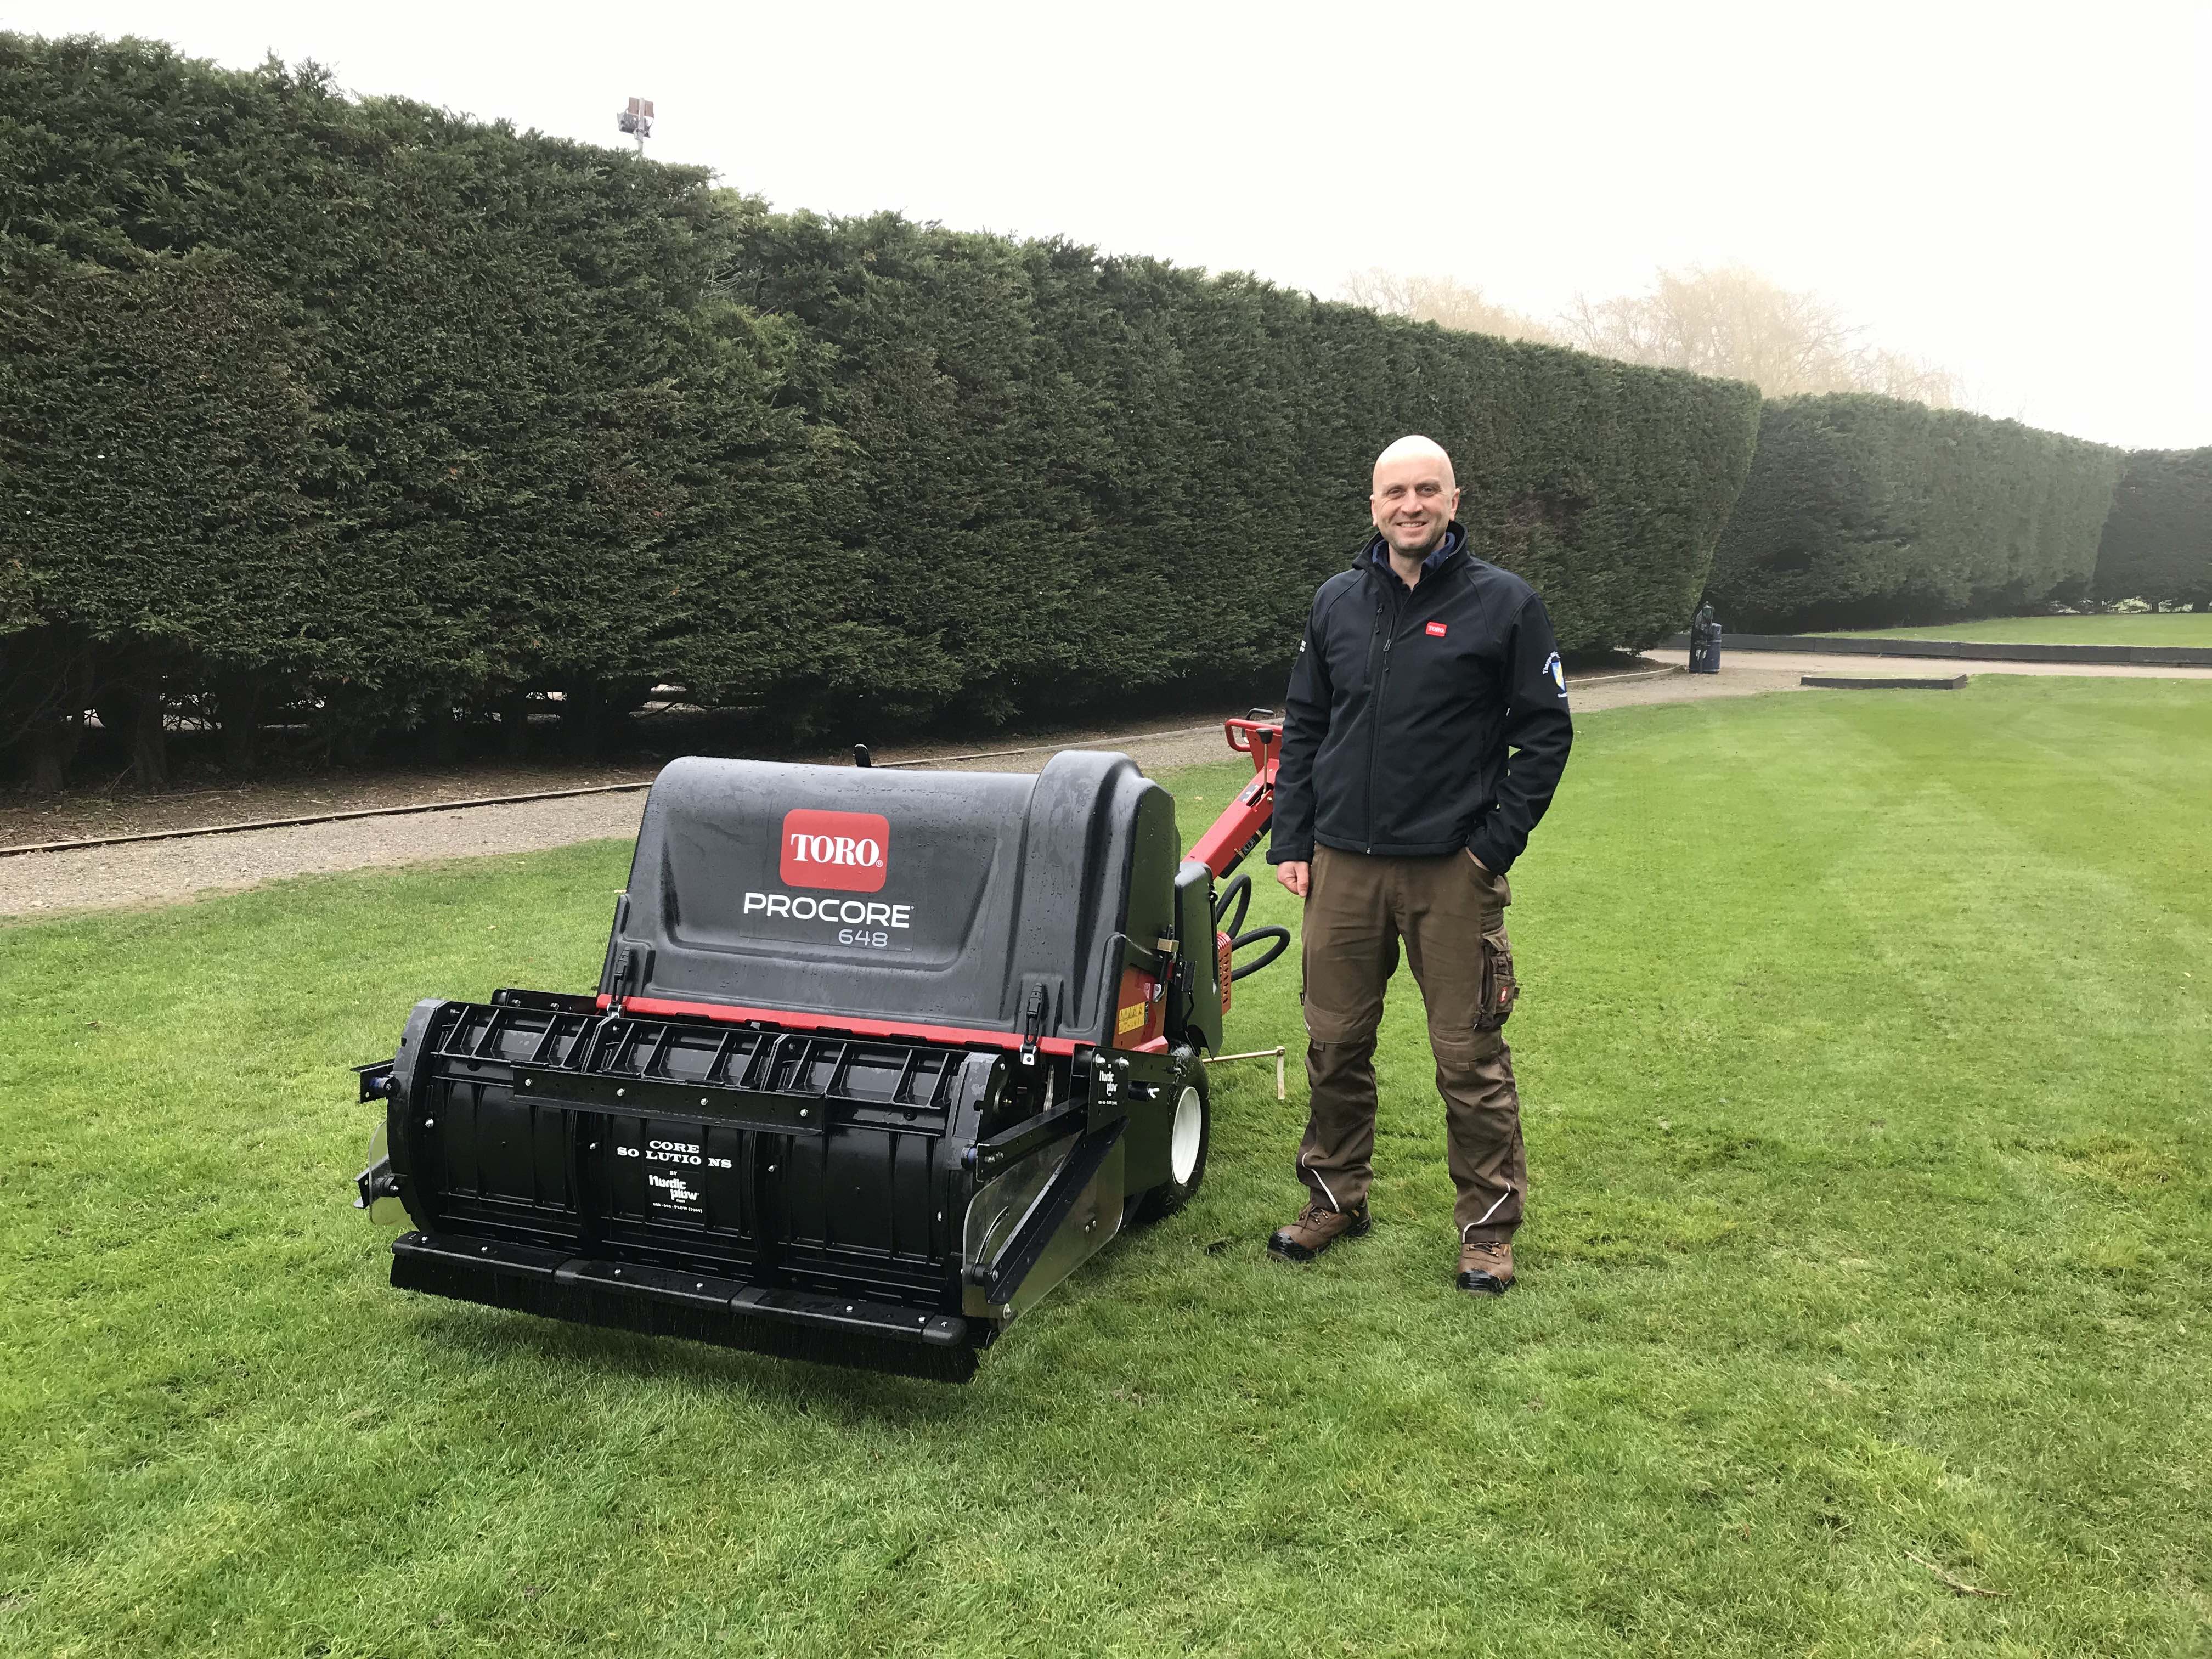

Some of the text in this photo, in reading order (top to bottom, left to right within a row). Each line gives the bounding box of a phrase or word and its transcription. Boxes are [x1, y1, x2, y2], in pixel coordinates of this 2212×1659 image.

[743, 892, 911, 928] PROCORE
[838, 929, 888, 947] 648
[648, 1140, 699, 1154] CORE
